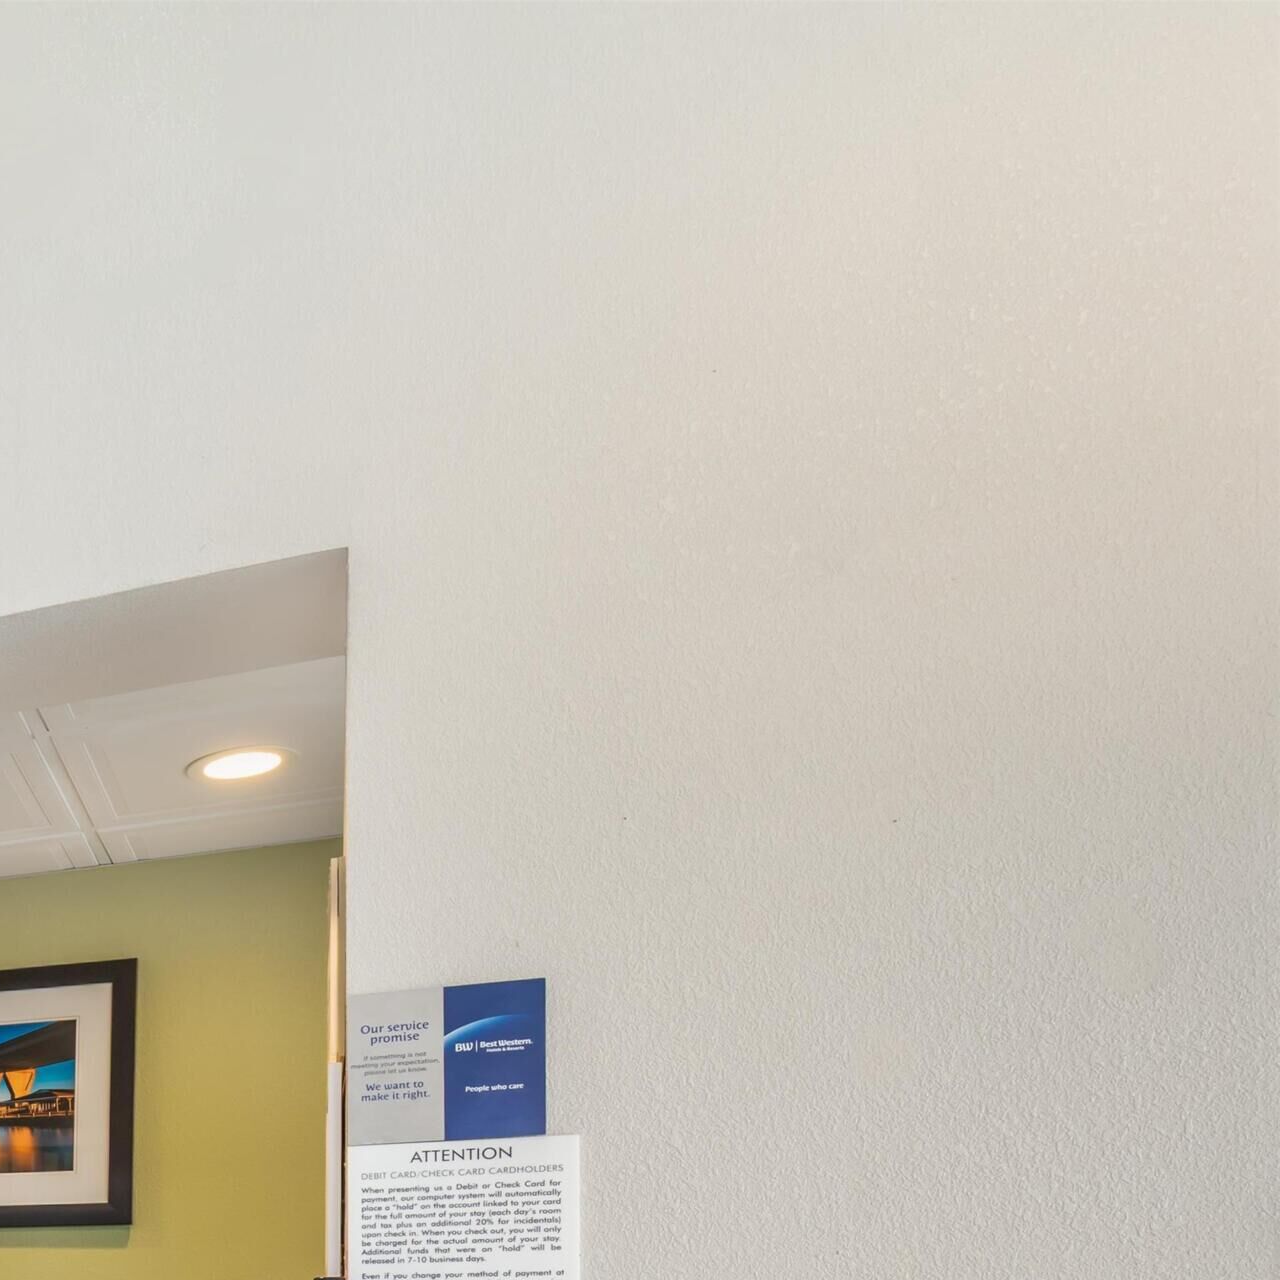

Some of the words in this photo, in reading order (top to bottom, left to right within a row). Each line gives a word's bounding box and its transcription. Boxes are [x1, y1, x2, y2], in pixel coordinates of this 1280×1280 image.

[360, 1025, 384, 1034] Our
[388, 1020, 429, 1032] service
[370, 1032, 420, 1046] promise
[455, 1042, 473, 1052] BW
[366, 1083, 381, 1091] We
[384, 1082, 410, 1090] want
[362, 1093, 389, 1101] make
[403, 1090, 430, 1100] right.
[410, 1147, 512, 1163] ATTENTION
[361, 1172, 387, 1180] DEBIT
[458, 1167, 486, 1176] CARD
[488, 1164, 564, 1174] CARDHOLDERS
[388, 1184, 430, 1194] presenting
[417, 1192, 455, 1202] computer
[458, 1190, 486, 1200] system
[505, 1188, 562, 1198] automatically
[361, 1204, 383, 1213] place
